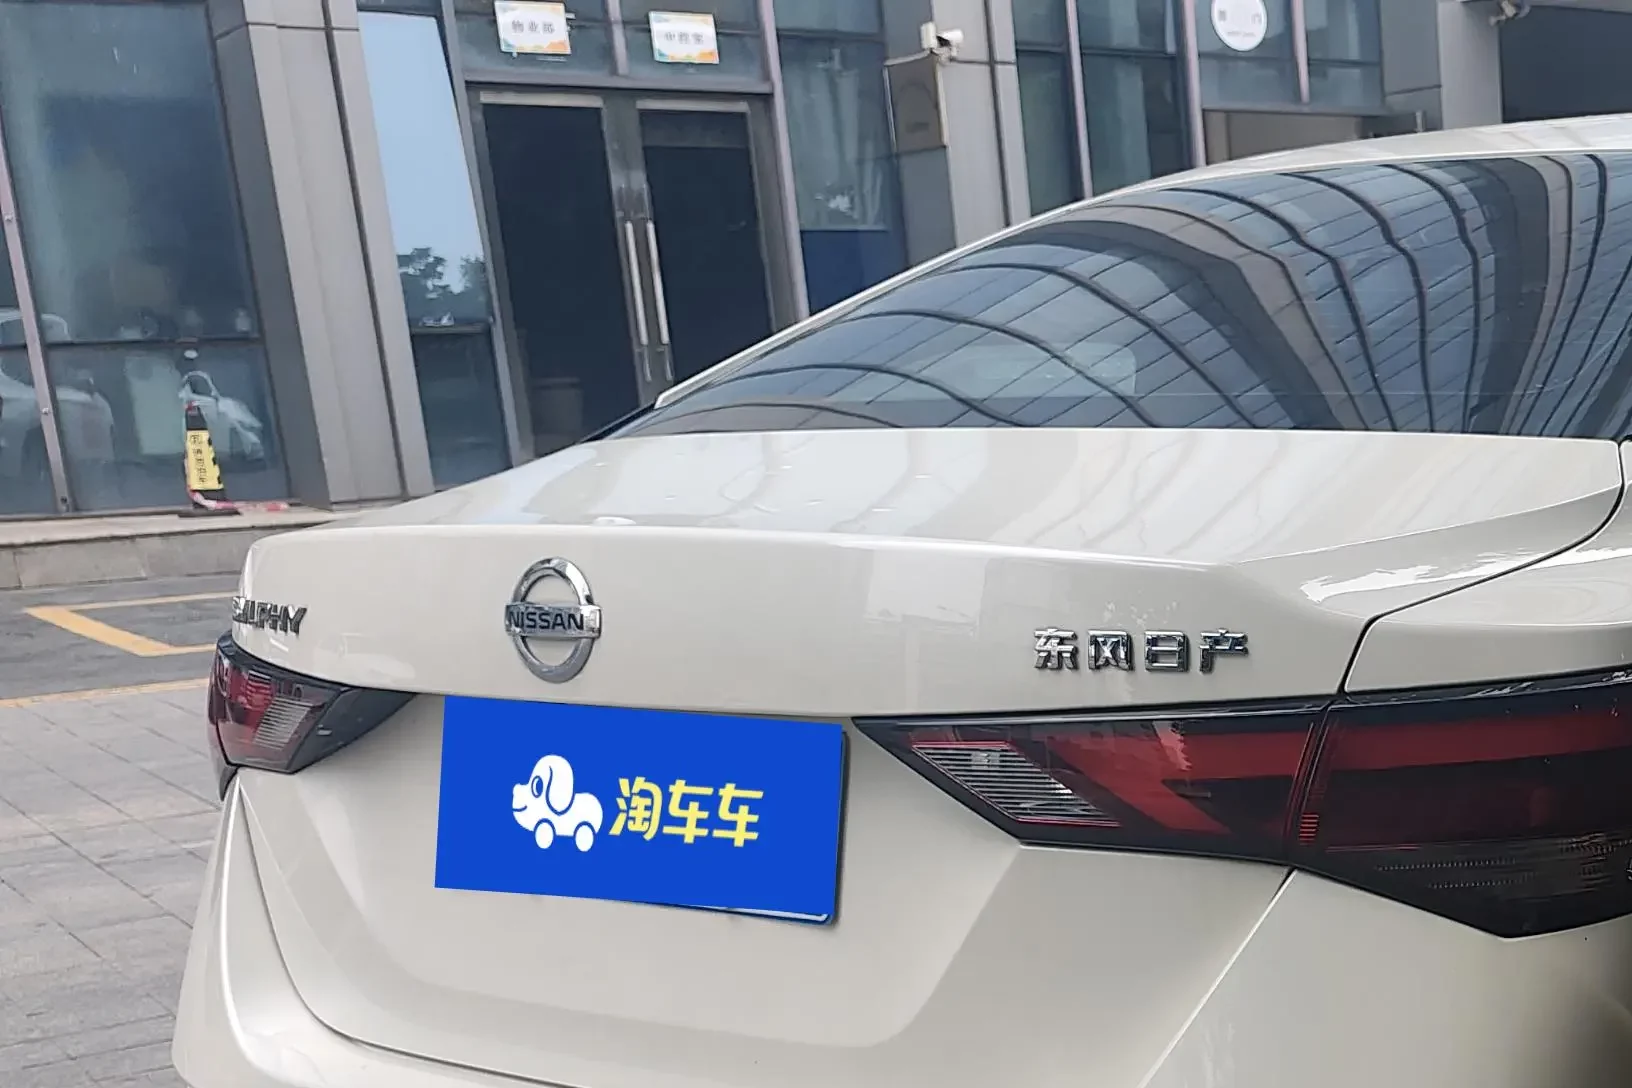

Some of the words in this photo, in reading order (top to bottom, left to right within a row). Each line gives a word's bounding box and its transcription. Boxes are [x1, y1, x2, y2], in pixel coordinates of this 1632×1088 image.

[508, 610, 585, 631] NISSAN
[1034, 627, 1248, 675] 东风日产
